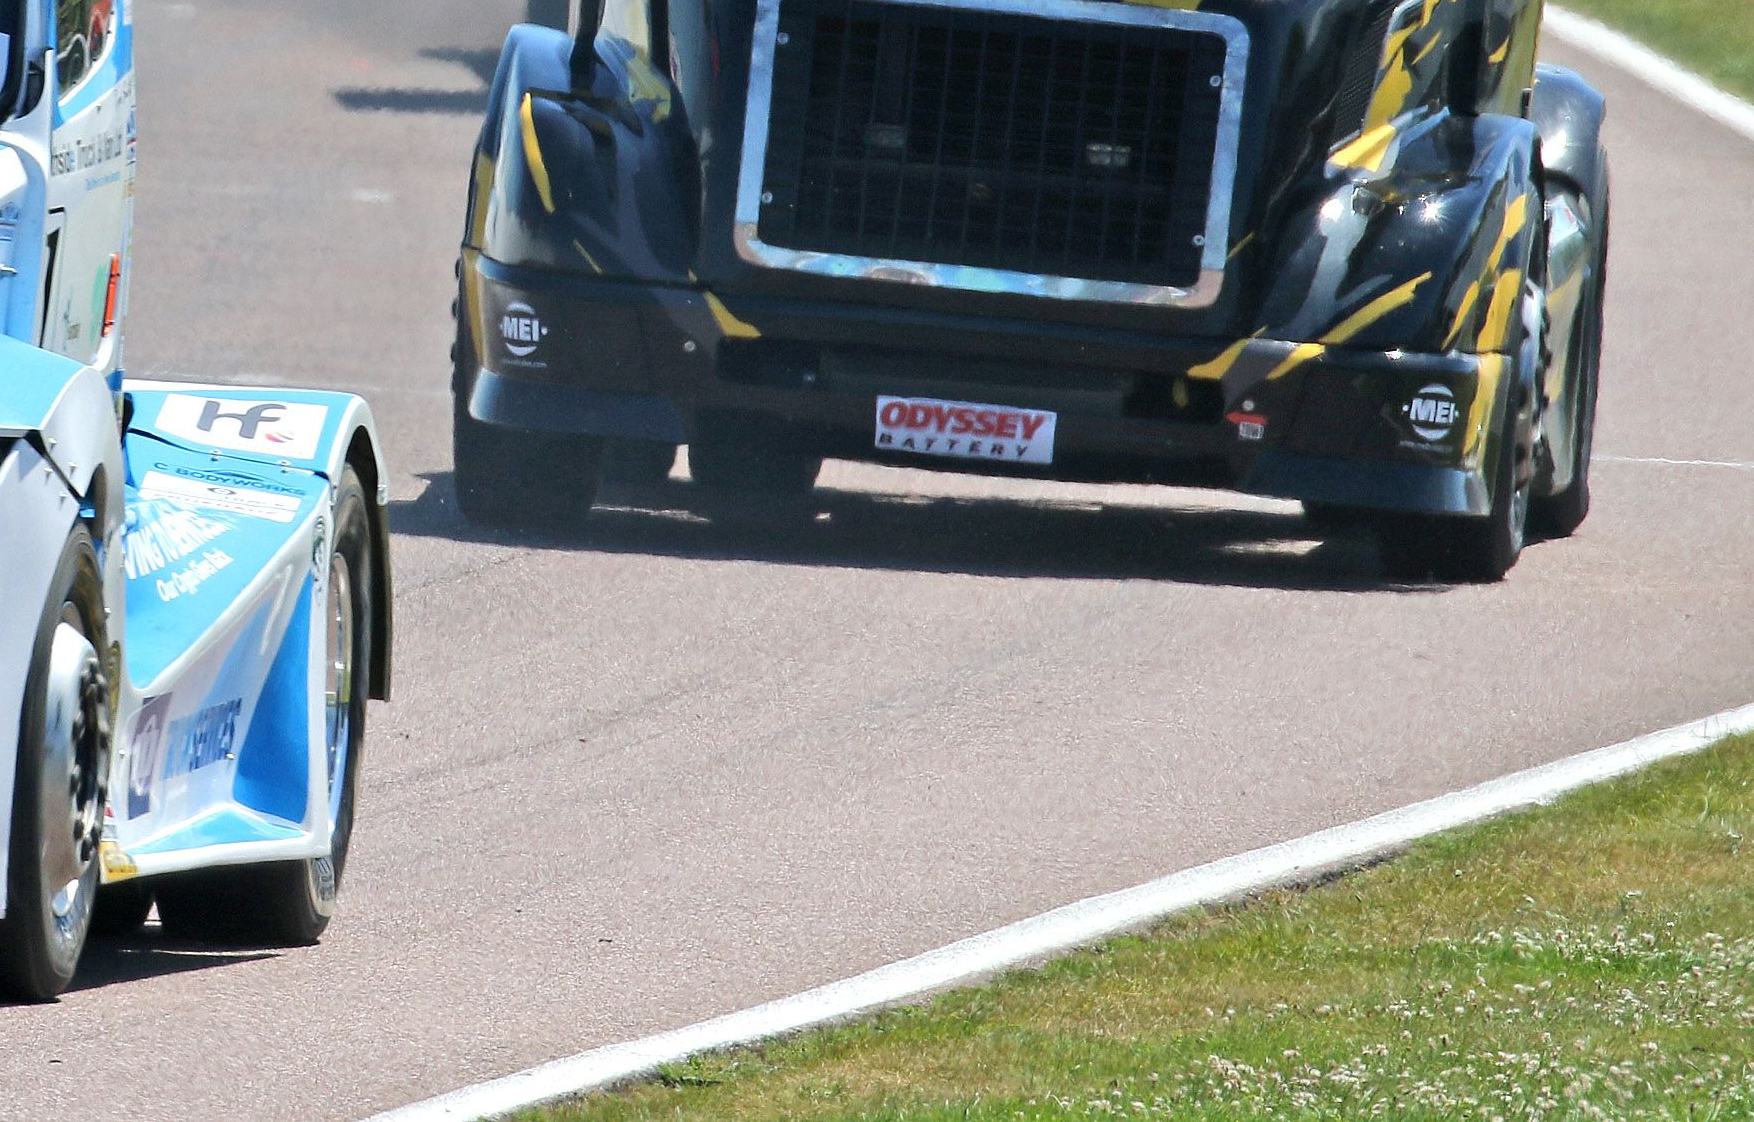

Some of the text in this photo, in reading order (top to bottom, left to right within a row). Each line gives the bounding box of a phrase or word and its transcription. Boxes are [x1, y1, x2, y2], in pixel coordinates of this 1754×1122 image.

[503, 316, 539, 341] MEI
[881, 401, 1045, 440] ODYSSEY
[1410, 398, 1455, 423] MEI
[879, 433, 1028, 457] BATTERY
[176, 467, 305, 495] BODYWORKS
